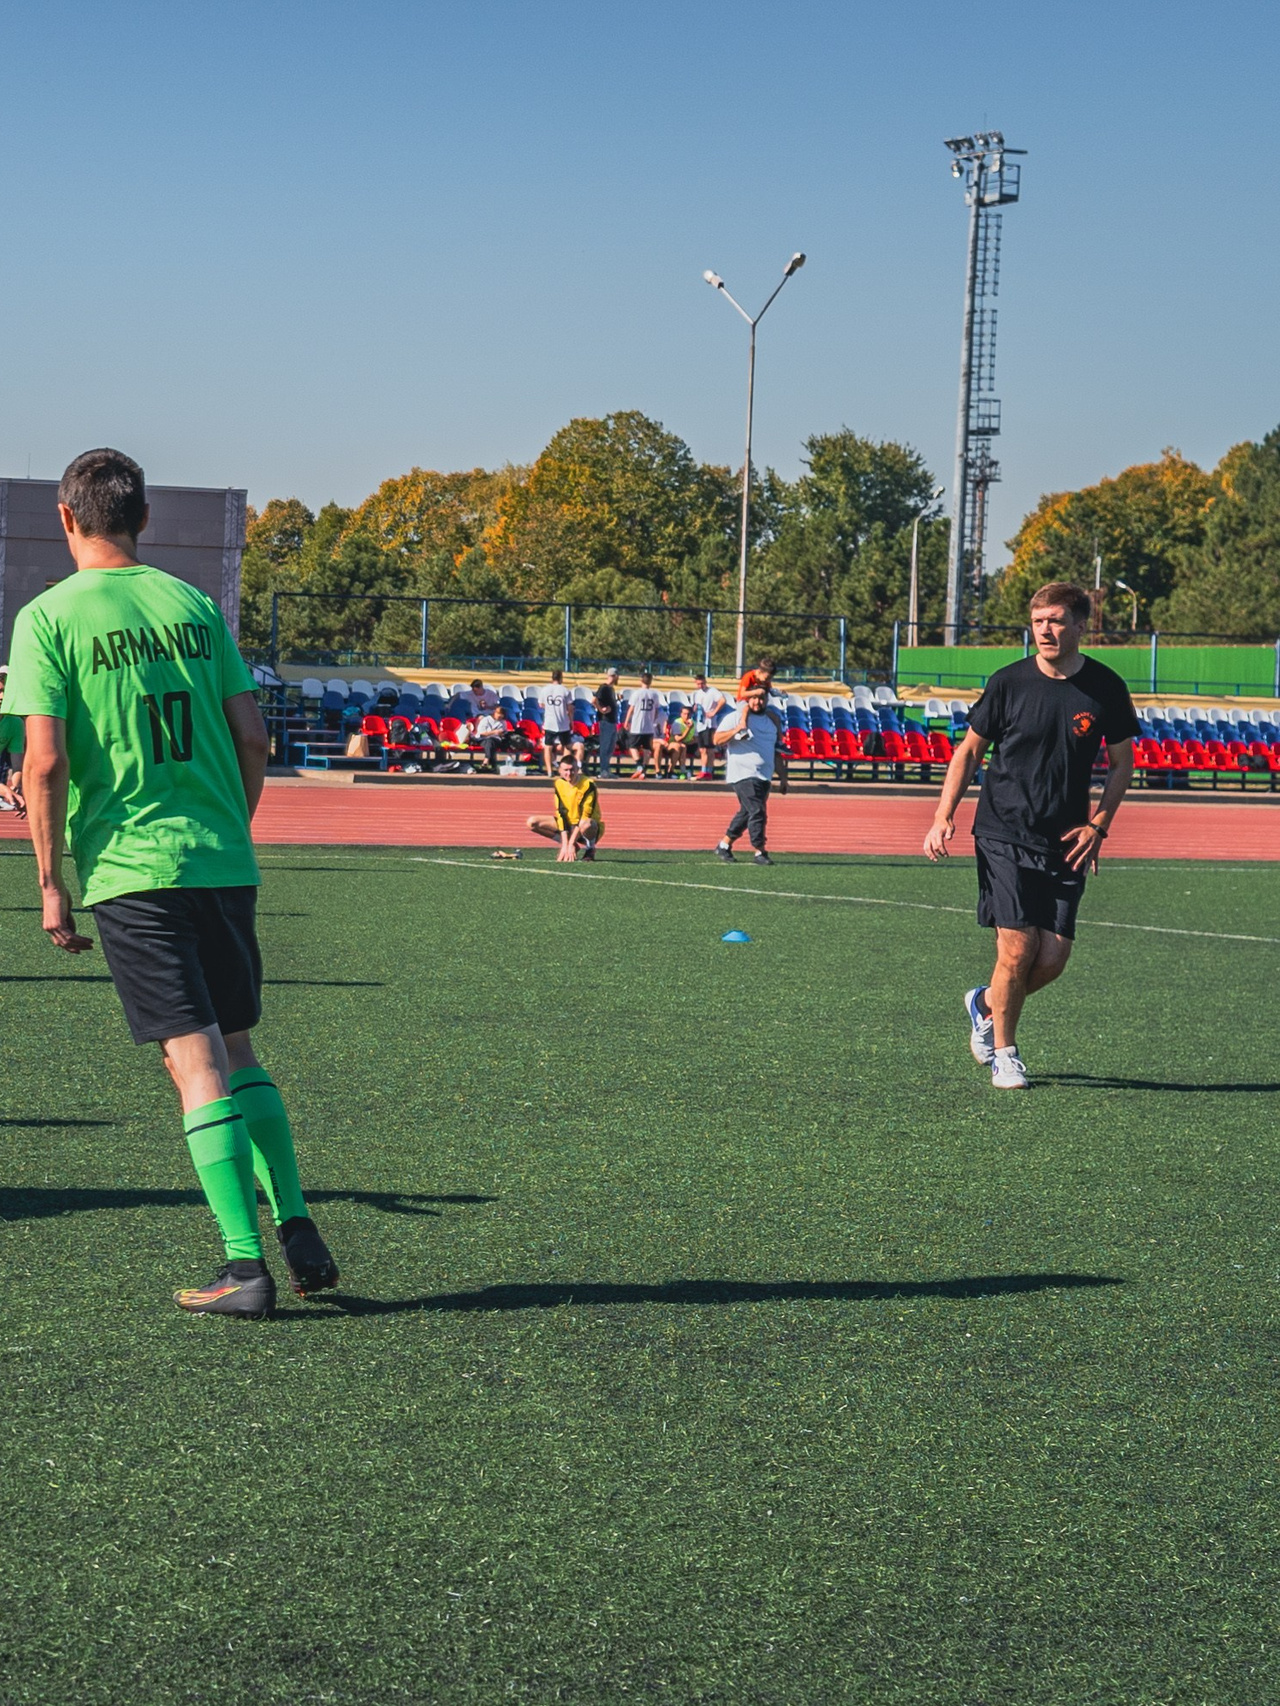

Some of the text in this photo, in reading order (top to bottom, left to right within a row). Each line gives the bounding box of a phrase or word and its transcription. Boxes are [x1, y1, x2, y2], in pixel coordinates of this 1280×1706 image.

[92, 622, 212, 675] ARMANDO
[142, 690, 194, 765] 10
[546, 695, 562, 707] 66
